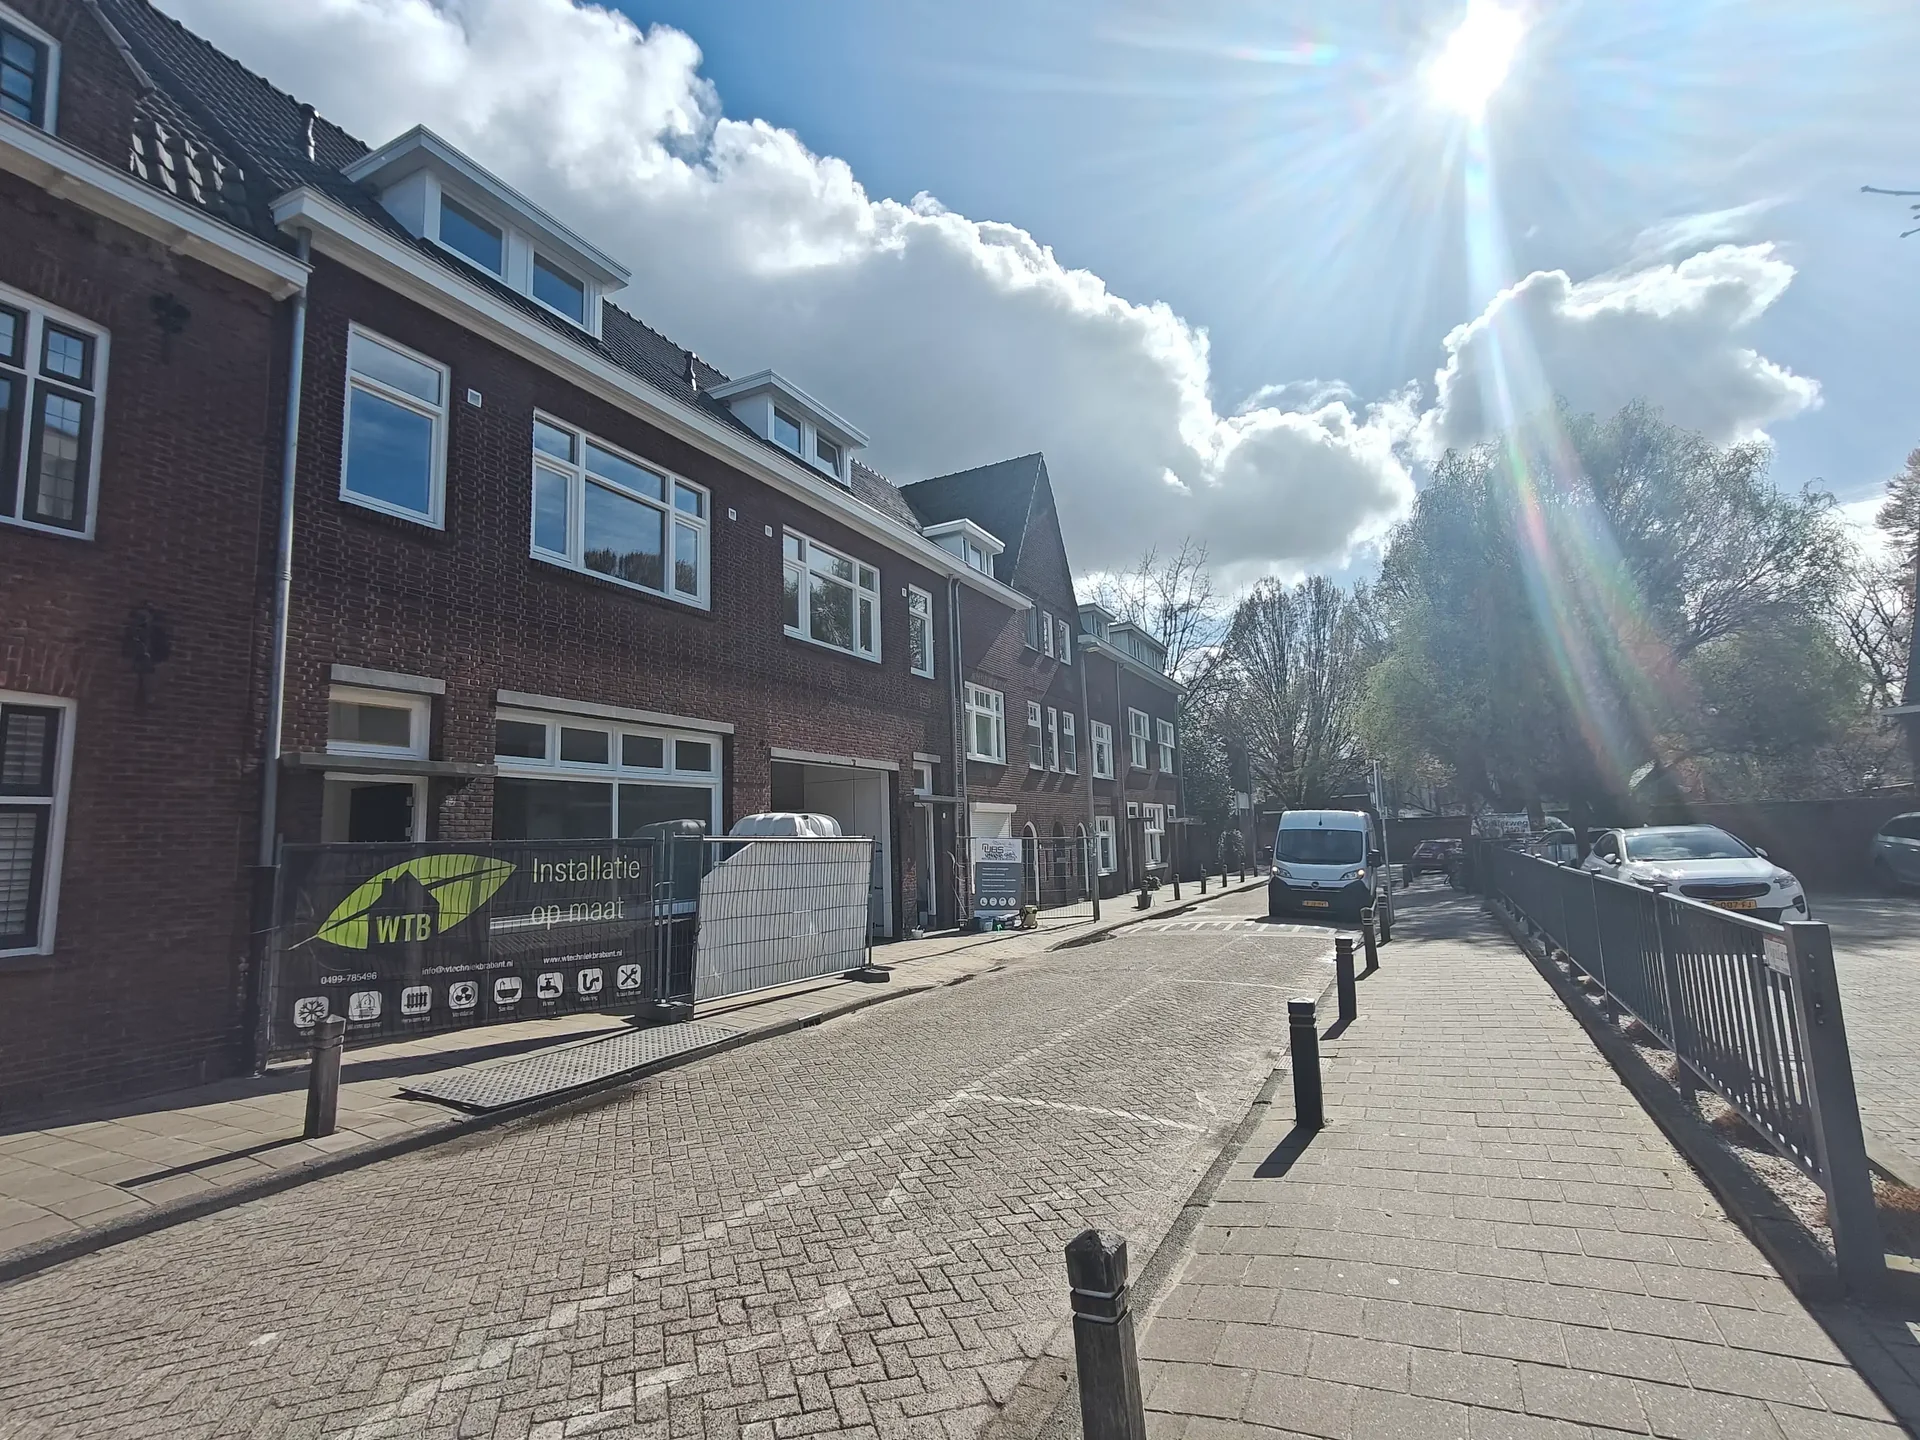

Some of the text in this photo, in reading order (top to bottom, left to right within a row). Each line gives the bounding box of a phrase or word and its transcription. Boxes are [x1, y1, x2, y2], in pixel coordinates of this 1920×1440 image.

[532, 855, 641, 884] Installatie
[531, 896, 625, 930] op maat
[376, 912, 431, 944] WTB
[421, 960, 514, 976] info@wtechniekbrabant.nl
[542, 949, 623, 965] www.wtechniekbrabant.nl
[320, 971, 378, 985] 0499-785496
